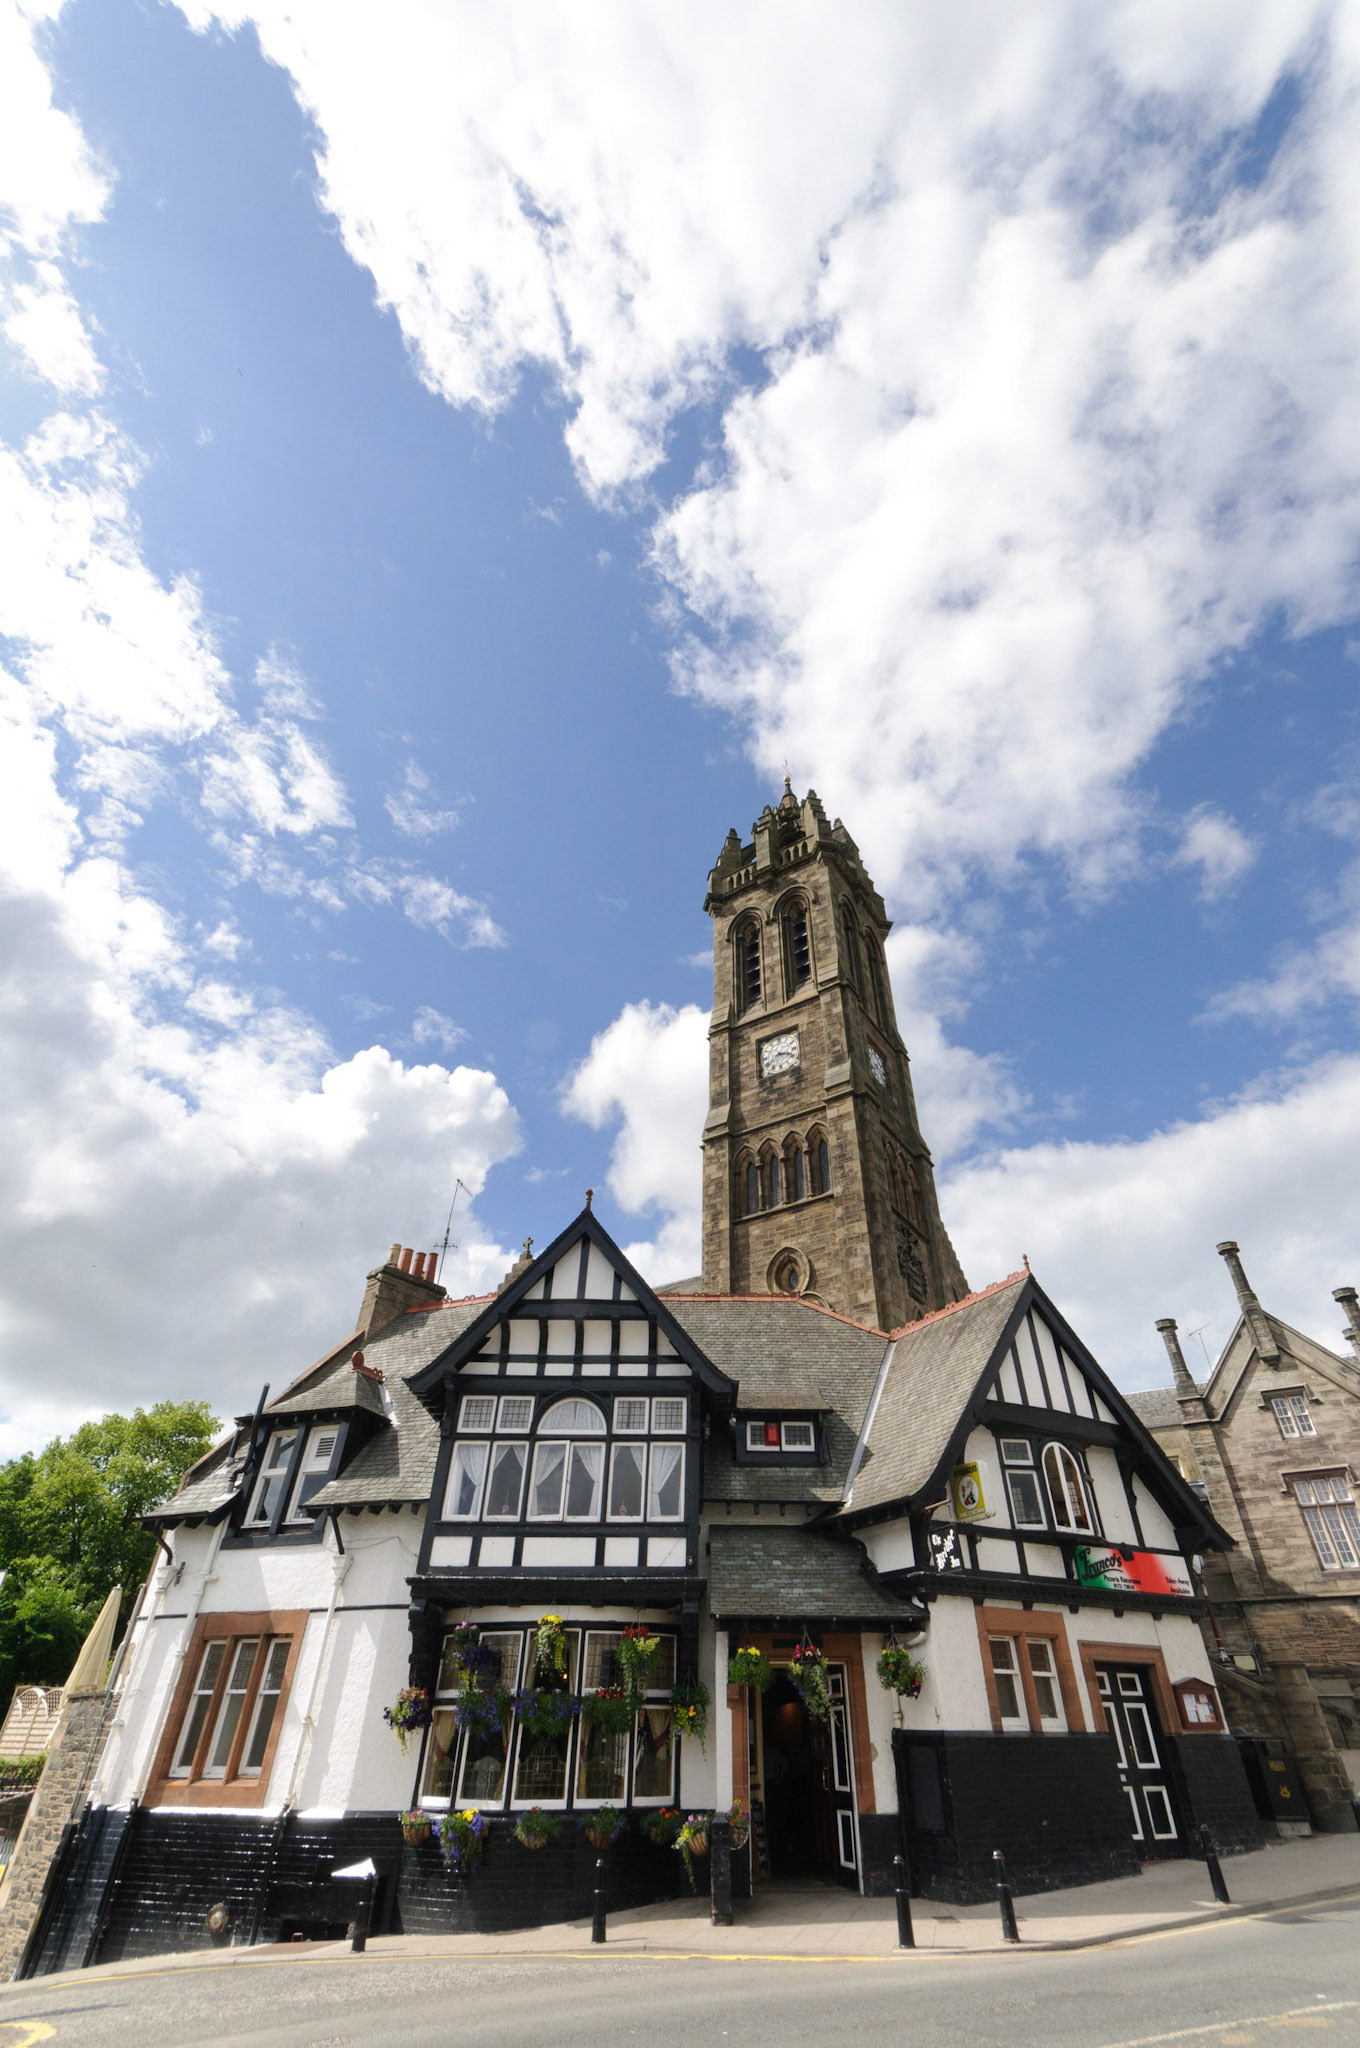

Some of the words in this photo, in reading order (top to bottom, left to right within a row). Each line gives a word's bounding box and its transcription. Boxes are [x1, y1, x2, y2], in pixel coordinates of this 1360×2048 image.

[936, 1529, 954, 1572] Bridge
[950, 1555, 960, 1568] Inn
[1079, 1547, 1122, 1581] Franco's
[1165, 1577, 1189, 1586] Take-Away
